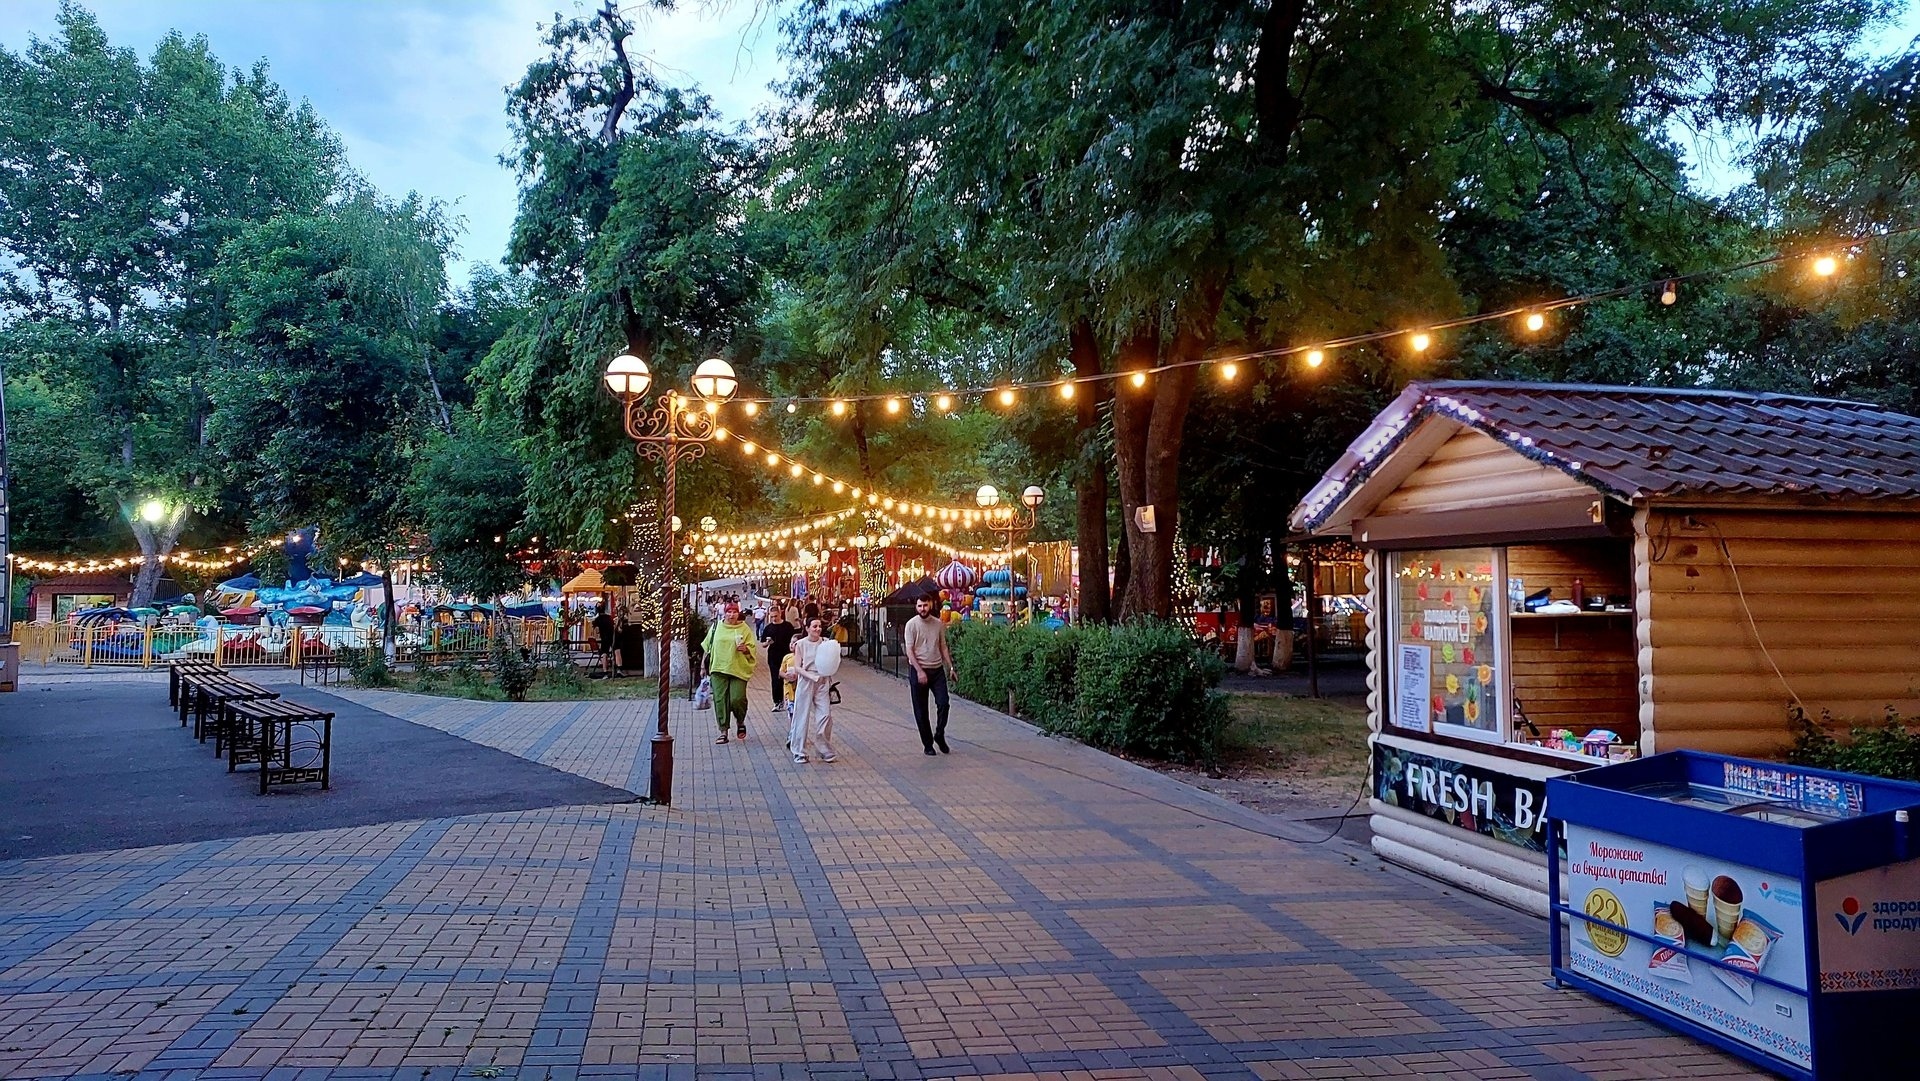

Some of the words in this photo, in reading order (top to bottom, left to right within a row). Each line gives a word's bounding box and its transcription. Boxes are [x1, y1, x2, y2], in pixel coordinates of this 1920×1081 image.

[1424, 625, 1459, 642] НАПИТКИ
[267, 771, 323, 785] PEPSI
[1406, 762, 1493, 820] FRESH
[1589, 841, 1644, 862] Мороженое
[1572, 863, 1581, 874] со
[1583, 861, 1617, 881] вкусом
[1619, 868, 1668, 886] детства!
[1592, 893, 1618, 924] 22
[1873, 917, 1920, 933] проду
